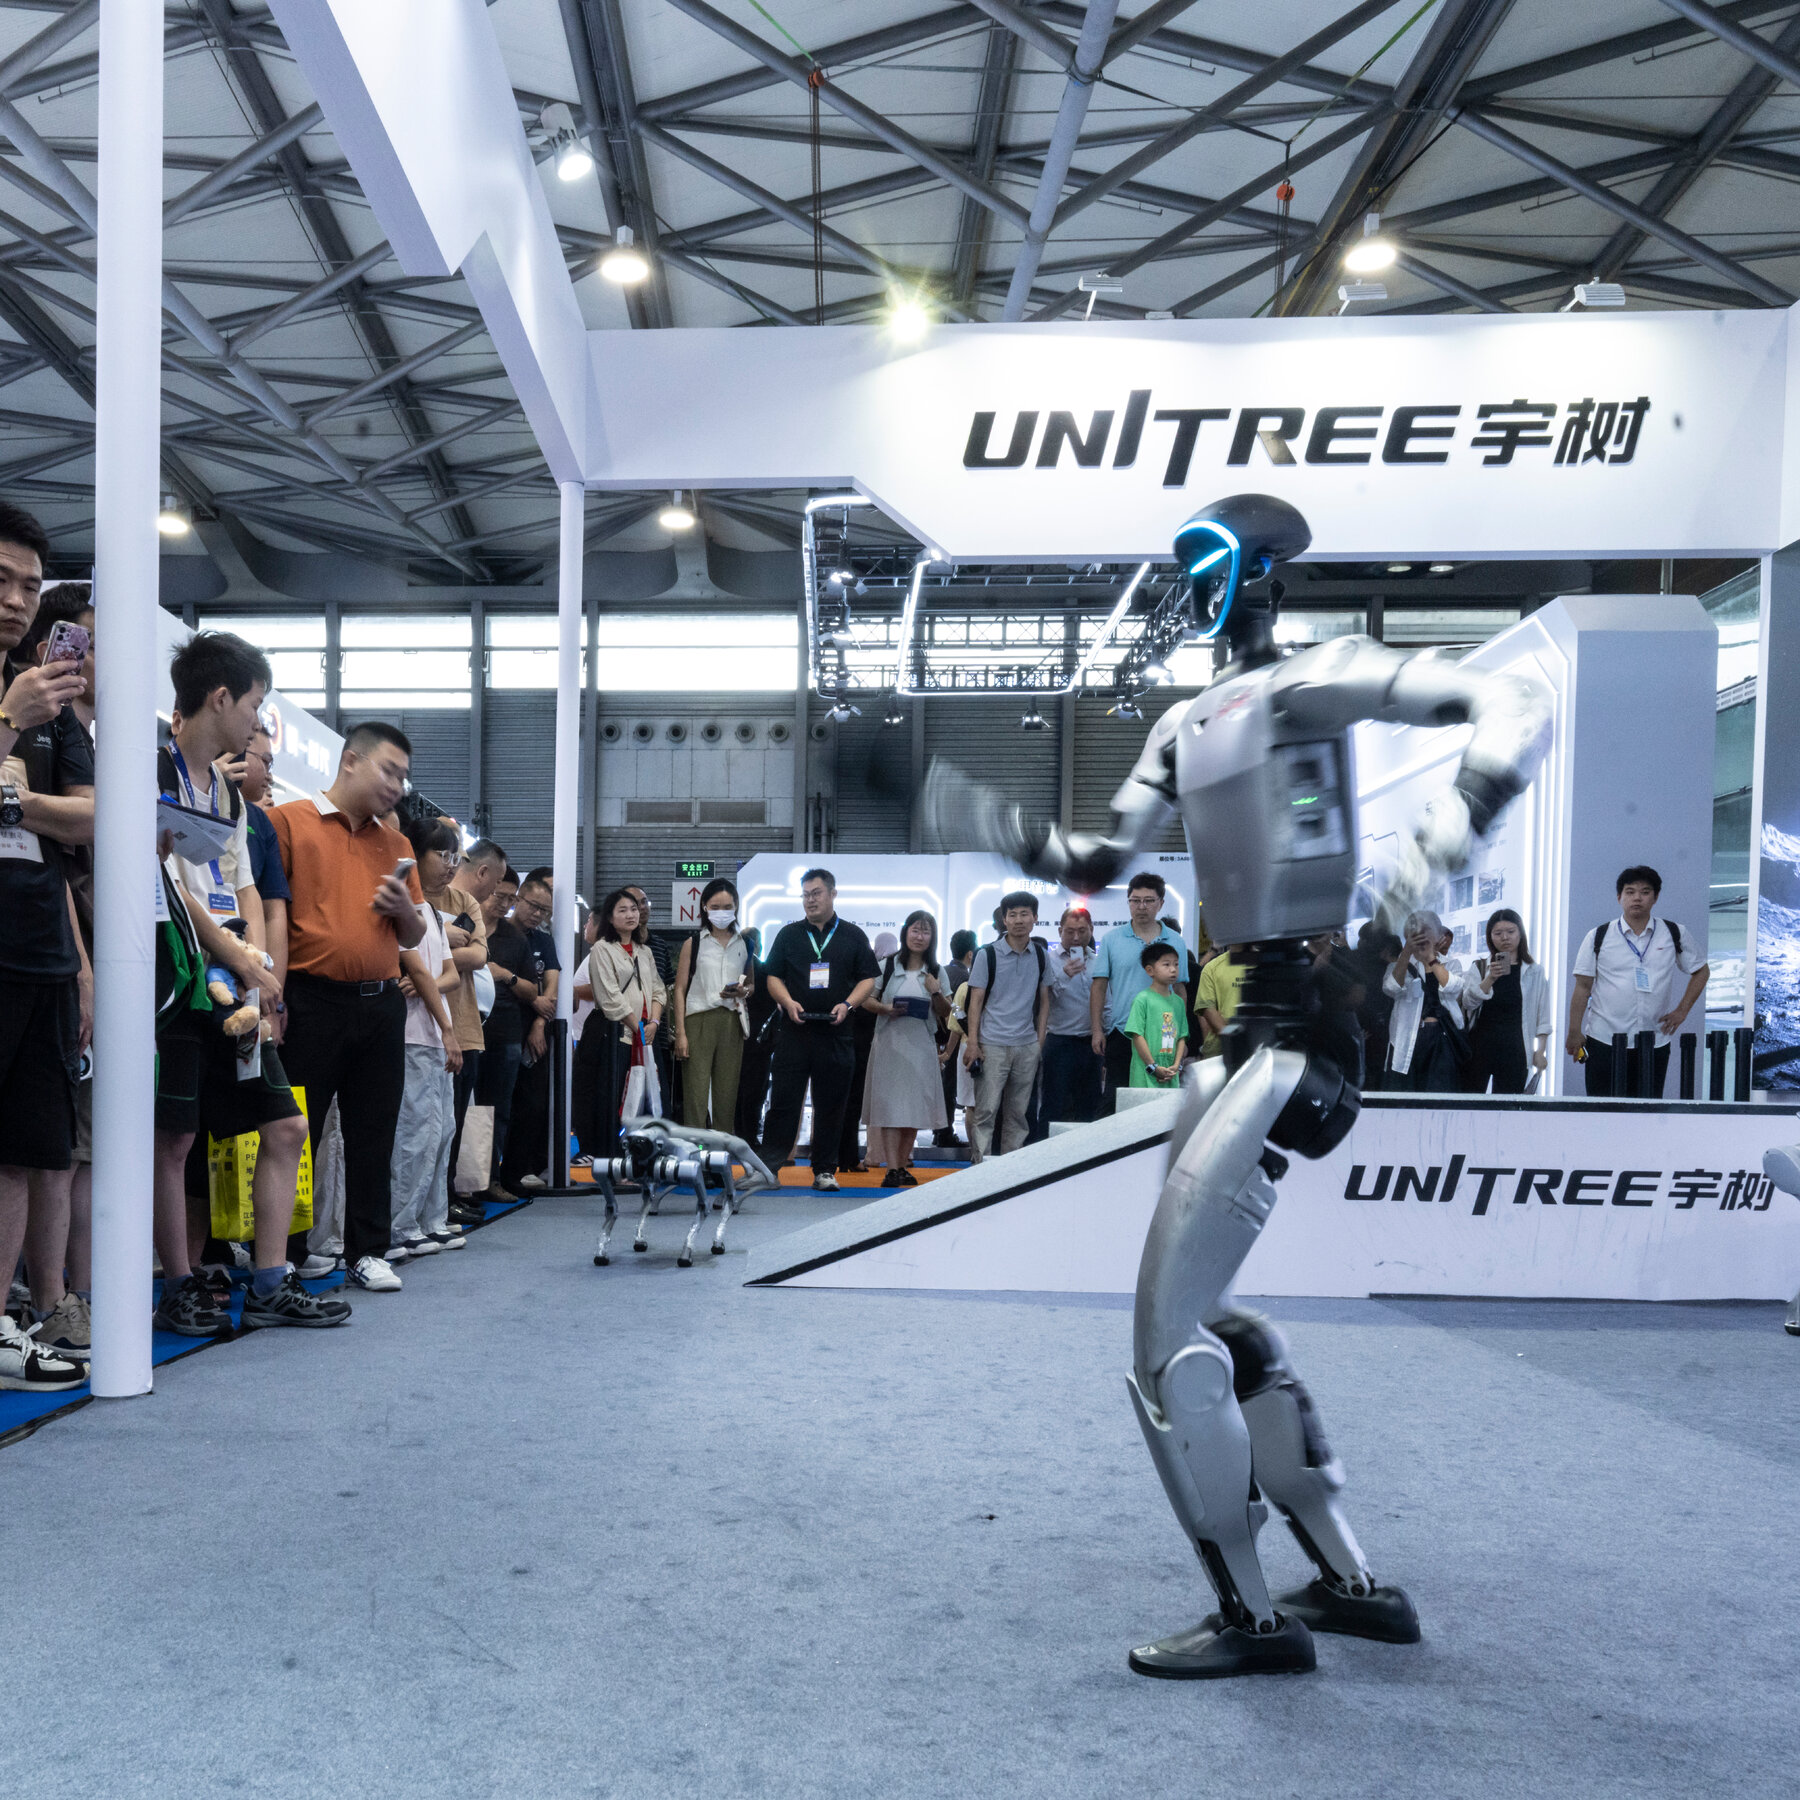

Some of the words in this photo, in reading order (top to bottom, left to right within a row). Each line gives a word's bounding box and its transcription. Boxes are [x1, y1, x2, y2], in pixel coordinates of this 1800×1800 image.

[962, 389, 1462, 488] UNITREE
[1470, 396, 1651, 465] 宇树
[681, 863, 709, 871] 安全出口
[1343, 1154, 1663, 1216] UNITREE
[1667, 1168, 1775, 1211] 宇树
